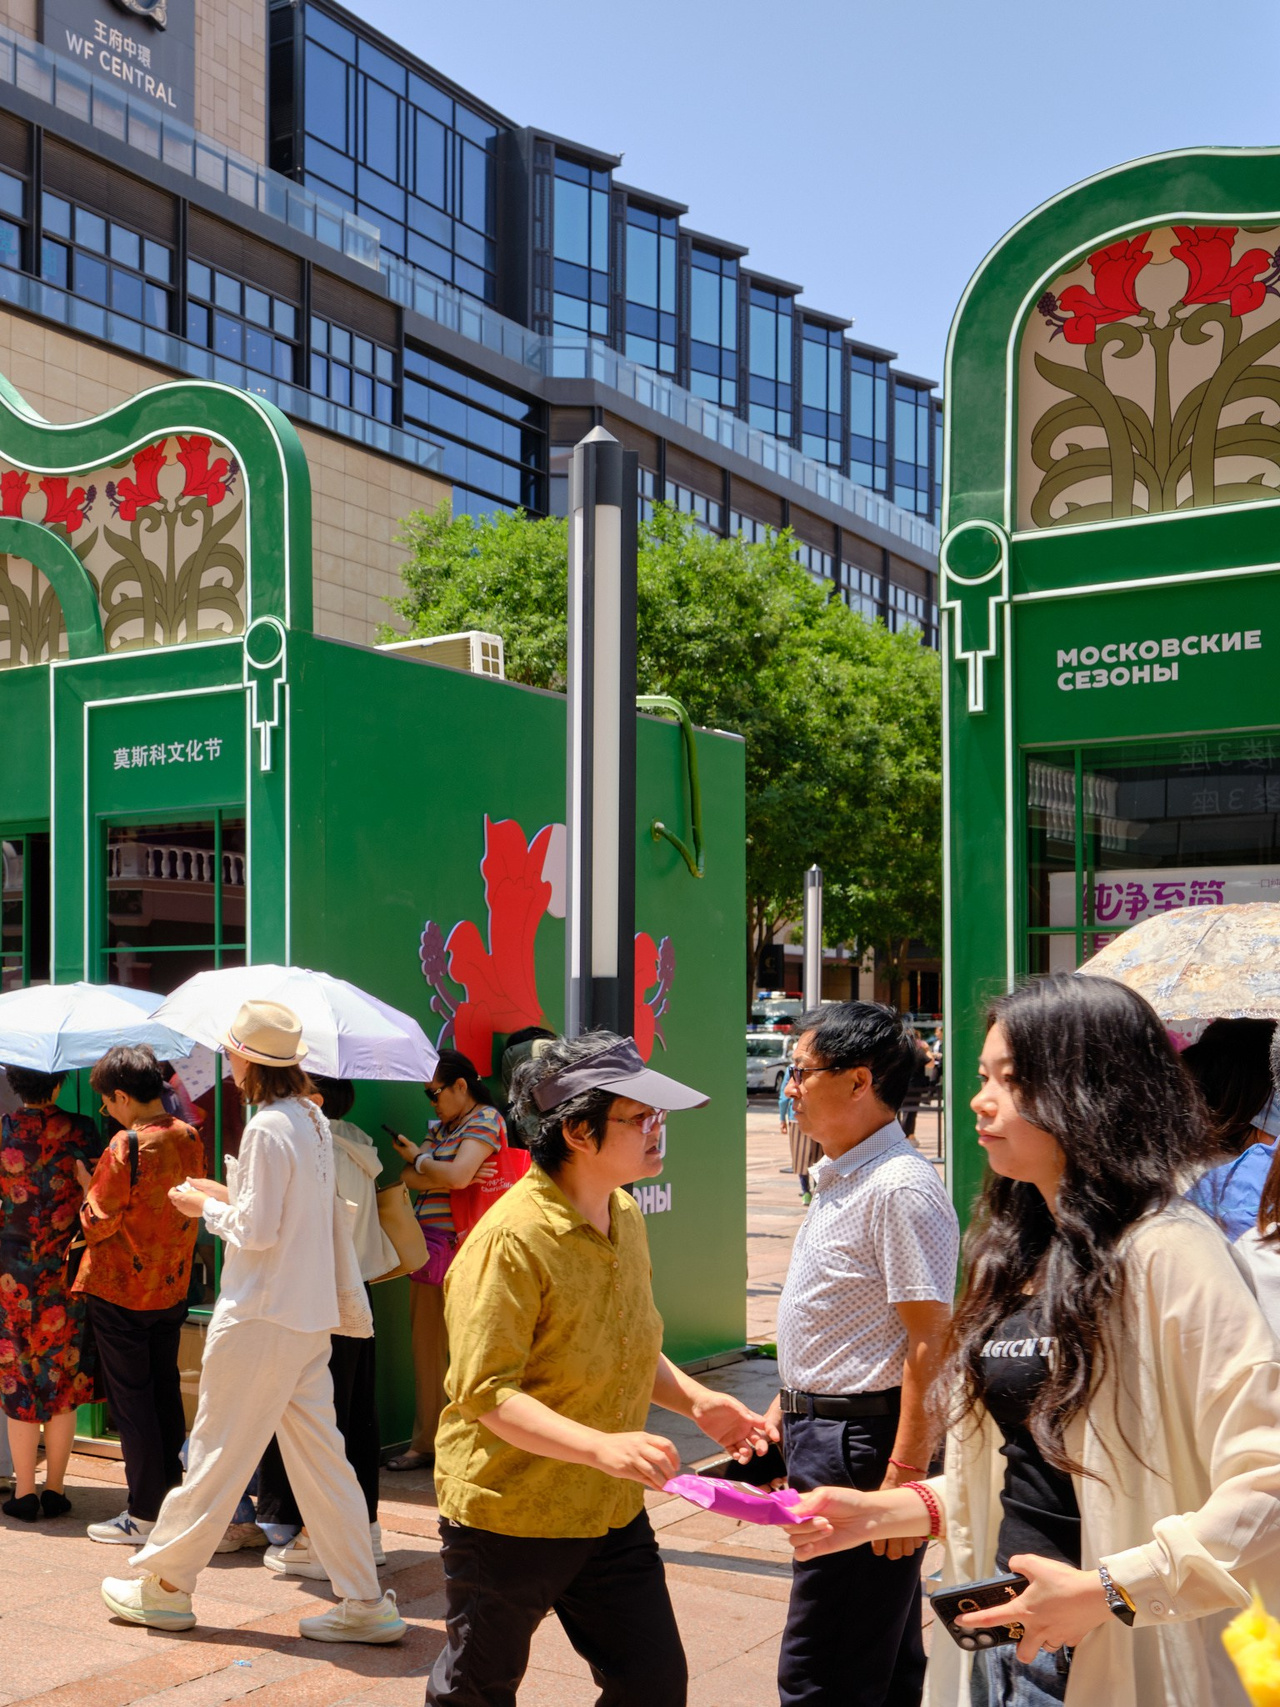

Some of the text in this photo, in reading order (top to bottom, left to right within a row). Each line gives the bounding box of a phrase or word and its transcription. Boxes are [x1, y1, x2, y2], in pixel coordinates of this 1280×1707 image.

[94, 19, 151, 69] 王府中環
[66, 30, 177, 108] WF CENTRAL
[1057, 629, 1262, 668] МОСКОВСКИЕ
[1057, 662, 1179, 691] СЕЗОНЫ
[113, 738, 223, 770] 莫斯科文化节
